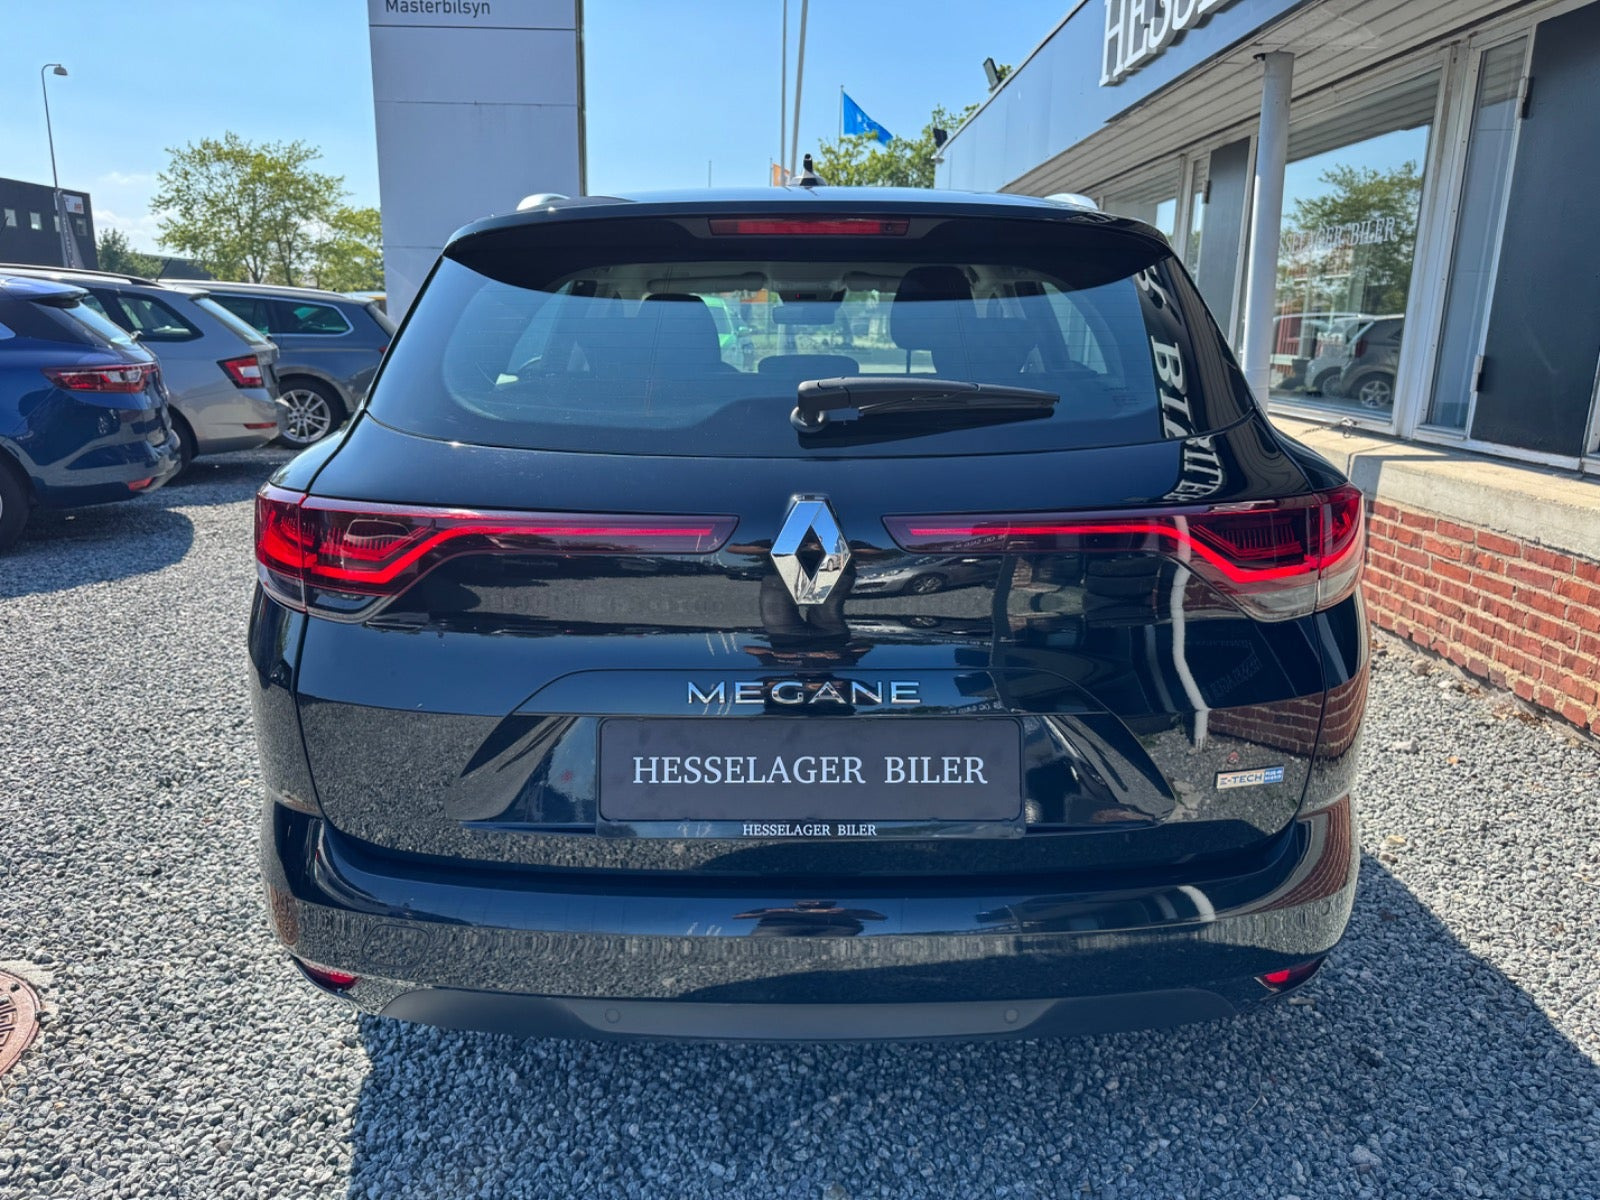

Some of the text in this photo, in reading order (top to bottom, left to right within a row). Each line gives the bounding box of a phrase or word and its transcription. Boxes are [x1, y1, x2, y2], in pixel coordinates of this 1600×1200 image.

[385, 0, 491, 18] Masterbilsyn
[687, 680, 922, 704] MEGANE
[632, 756, 989, 784] HESSELAGER BILER
[742, 823, 877, 837] HESSELAGER BILER
